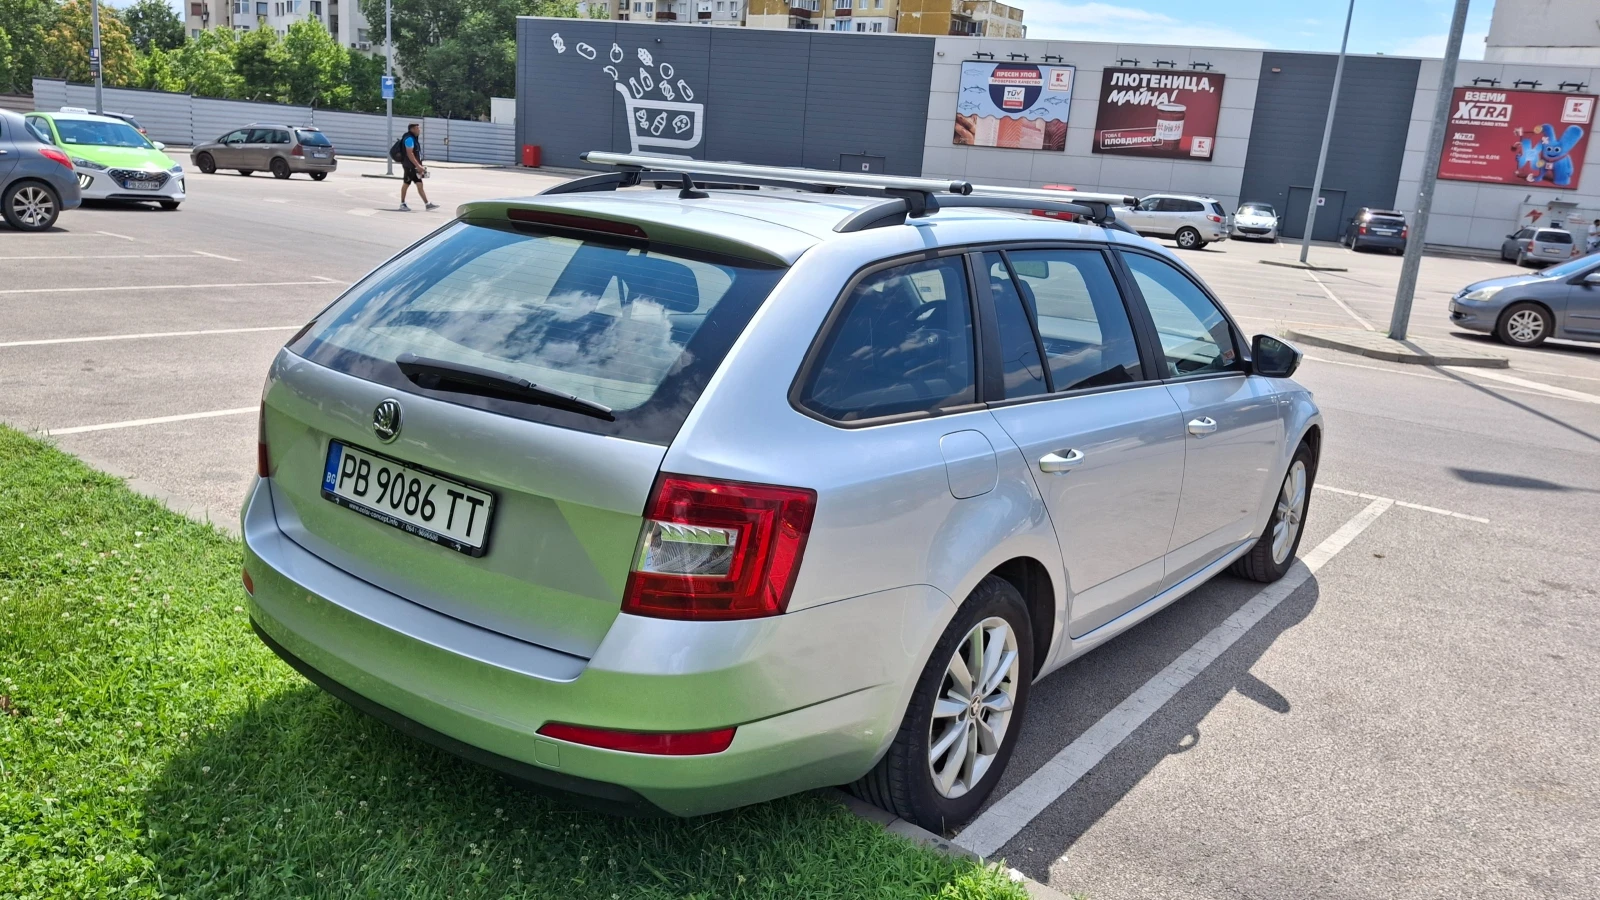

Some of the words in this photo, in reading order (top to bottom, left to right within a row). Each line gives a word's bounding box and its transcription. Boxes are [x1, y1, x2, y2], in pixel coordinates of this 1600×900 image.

[1111, 72, 1215, 93] ЛЮТЕНИЦА,
[1107, 87, 1178, 106] МАЙНА!
[1465, 91, 1506, 102] ВЗЕМИ
[1452, 102, 1512, 121] XTRA
[326, 473, 336, 485] BG
[338, 454, 371, 497] PB
[375, 467, 436, 522] 9086
[446, 489, 484, 537] TT
[349, 503, 399, 526] www.color-concept.info
